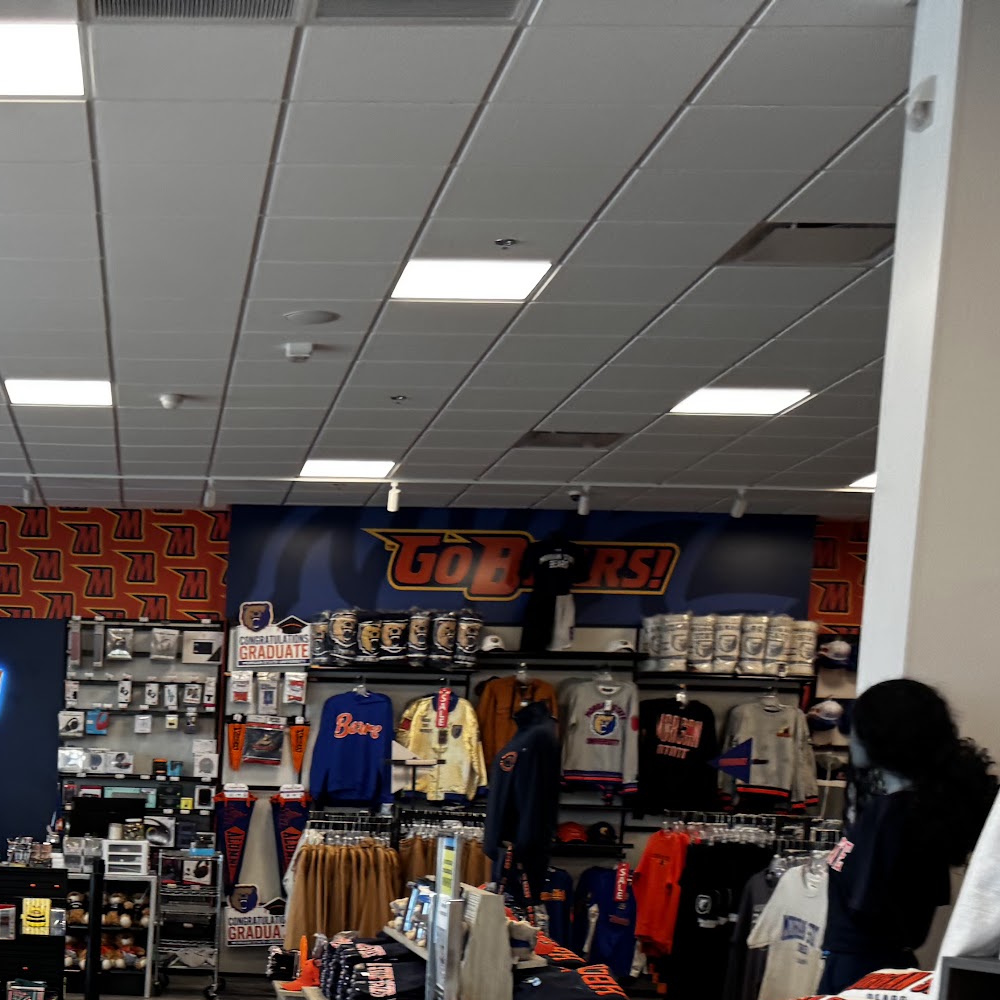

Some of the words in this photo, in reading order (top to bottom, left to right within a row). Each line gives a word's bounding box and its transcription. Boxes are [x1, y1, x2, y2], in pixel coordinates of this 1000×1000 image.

[239, 634, 309, 645] CONGRATULATIONS
[239, 644, 309, 660] GRADUATE
[437, 696, 447, 726] SALE
[616, 868, 627, 900] SALE
[228, 926, 281, 940] GRADUA
